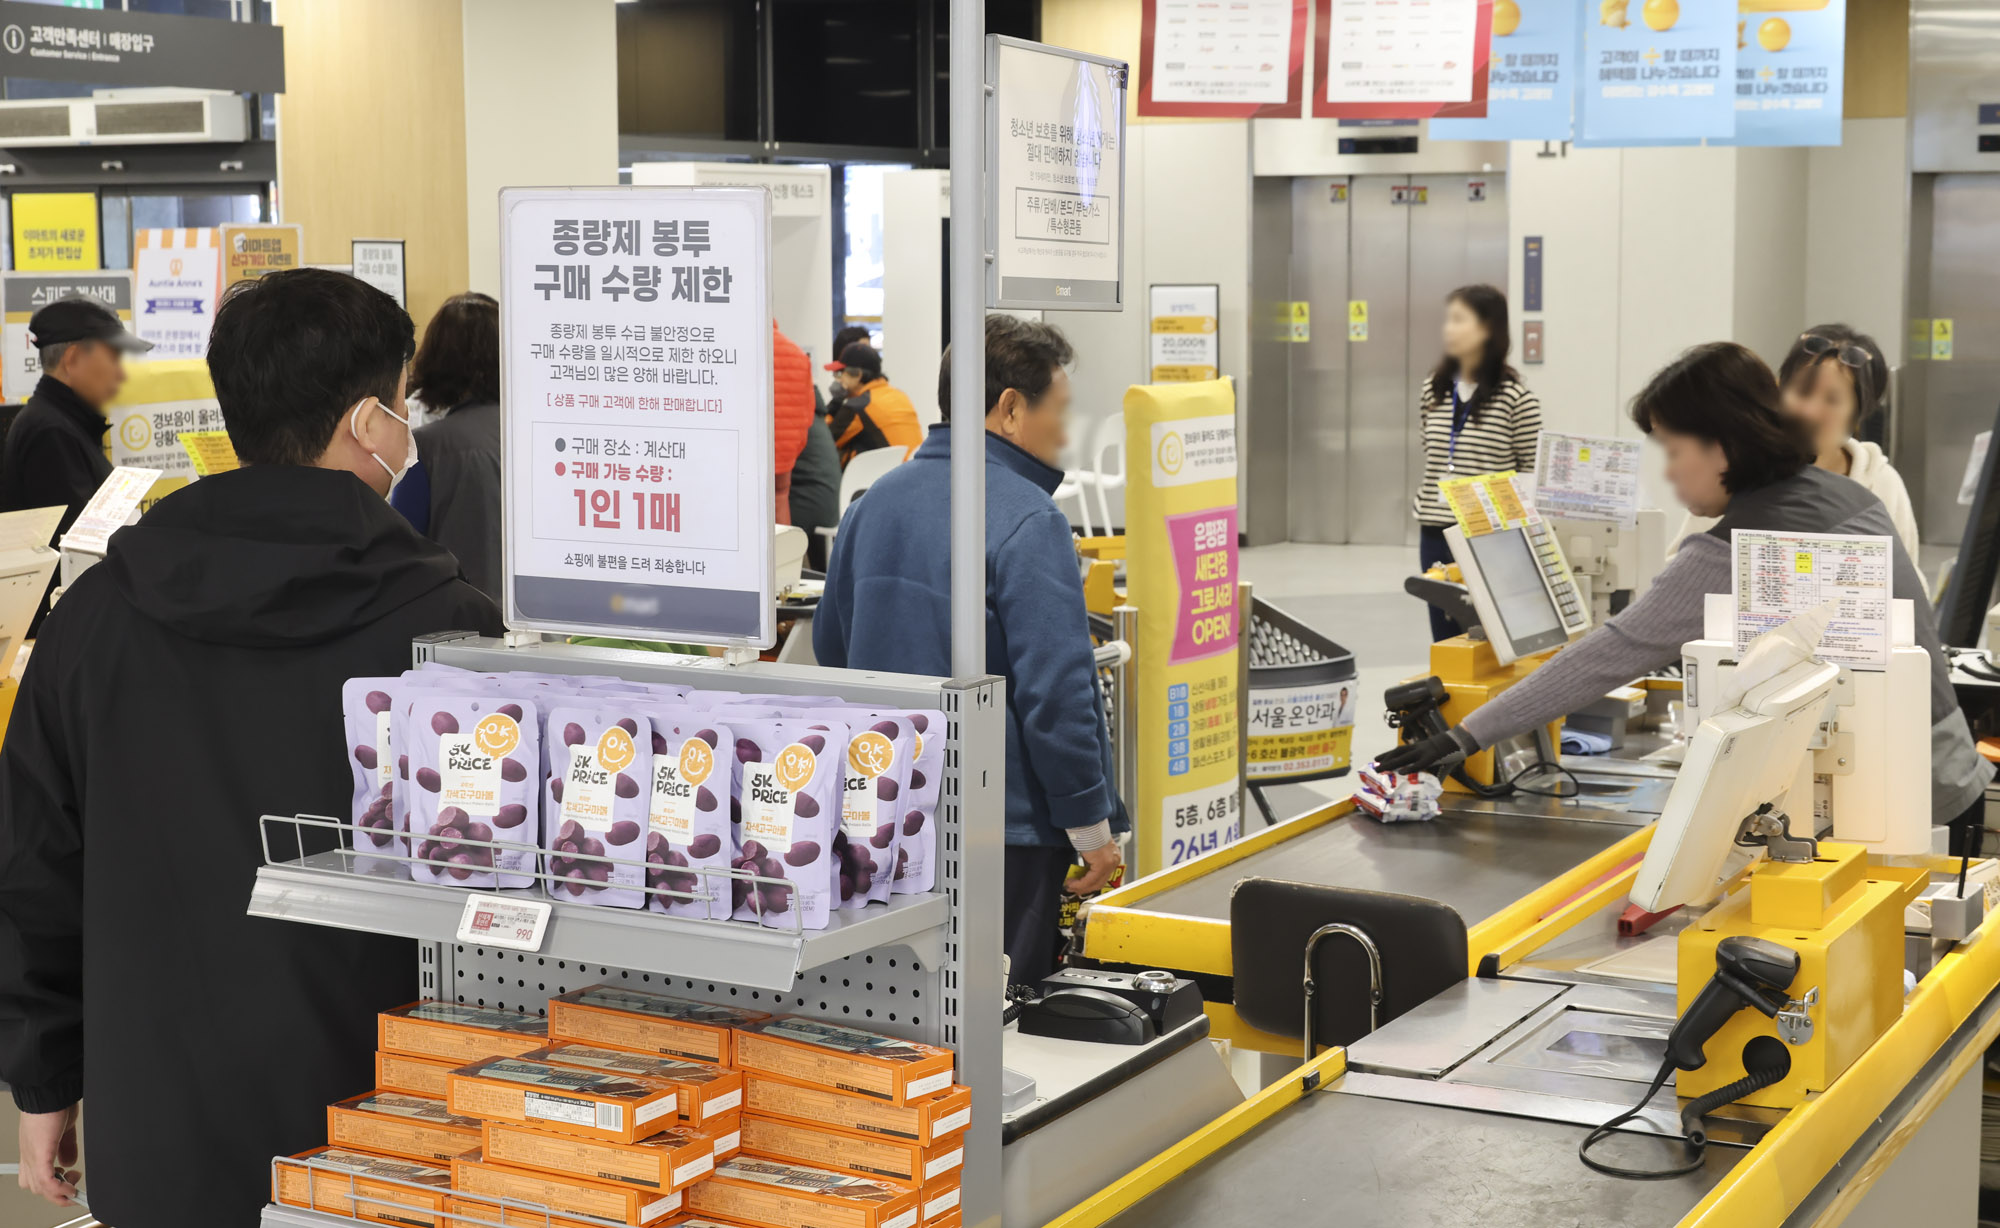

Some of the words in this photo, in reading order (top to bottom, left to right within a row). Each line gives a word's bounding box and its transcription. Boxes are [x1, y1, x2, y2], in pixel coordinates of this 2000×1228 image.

[1011, 118, 1033, 139] 청소년
[1035, 122, 1057, 142] 보호를
[1059, 125, 1073, 144] 위해
[1027, 143, 1041, 162] 절대
[1044, 145, 1072, 166] 판매하지
[552, 219, 640, 257] 종량제
[652, 220, 711, 258] 봉투
[534, 264, 591, 301] 구매
[601, 265, 661, 302] 수량
[671, 266, 733, 304] 제한
[550, 323, 588, 341] 종량제
[592, 324, 617, 341] 봉투
[621, 325, 646, 342] 수급
[650, 326, 716, 343] 불안정으로
[530, 344, 555, 360] 구매
[559, 344, 597, 361] 수량을
[601, 345, 665, 363] 일시적으로
[669, 346, 695, 364] 제한
[698, 347, 737, 365] 하오니
[550, 364, 600, 382] 고객님의
[604, 365, 629, 383] 많은
[633, 367, 659, 384] 양해
[663, 368, 718, 386] 바랍니다.
[578, 394, 600, 409] 구매
[603, 395, 635, 410] 고객에
[638, 396, 660, 411] 한해
[663, 397, 722, 413] 판매합니다]
[153, 410, 194, 430] 경보음이
[572, 437, 599, 456] 구매
[604, 438, 631, 457] 장소
[644, 440, 686, 460] 계산대
[572, 461, 599, 480] 구매
[604, 463, 631, 481] 가능
[635, 464, 664, 483] 수량
[573, 489, 620, 529] 1인
[632, 492, 681, 533] 1매
[1194, 518, 1228, 551] 은평점
[564, 552, 594, 569] 쇼핑에
[597, 554, 628, 571] 불편을
[631, 556, 651, 572] 드려
[654, 558, 706, 576] 죄송합니다
[1195, 550, 1228, 582] 새단장
[1191, 582, 1232, 615] 그로서리
[449, 743, 471, 757] 5K
[858, 741, 884, 755] OK
[574, 755, 592, 768] 5K
[657, 766, 676, 781] 5K
[751, 773, 772, 788] 5K
[1176, 804, 1202, 829] 5층,
[1207, 797, 1226, 820] 6층
[516, 928, 533, 941] 990
